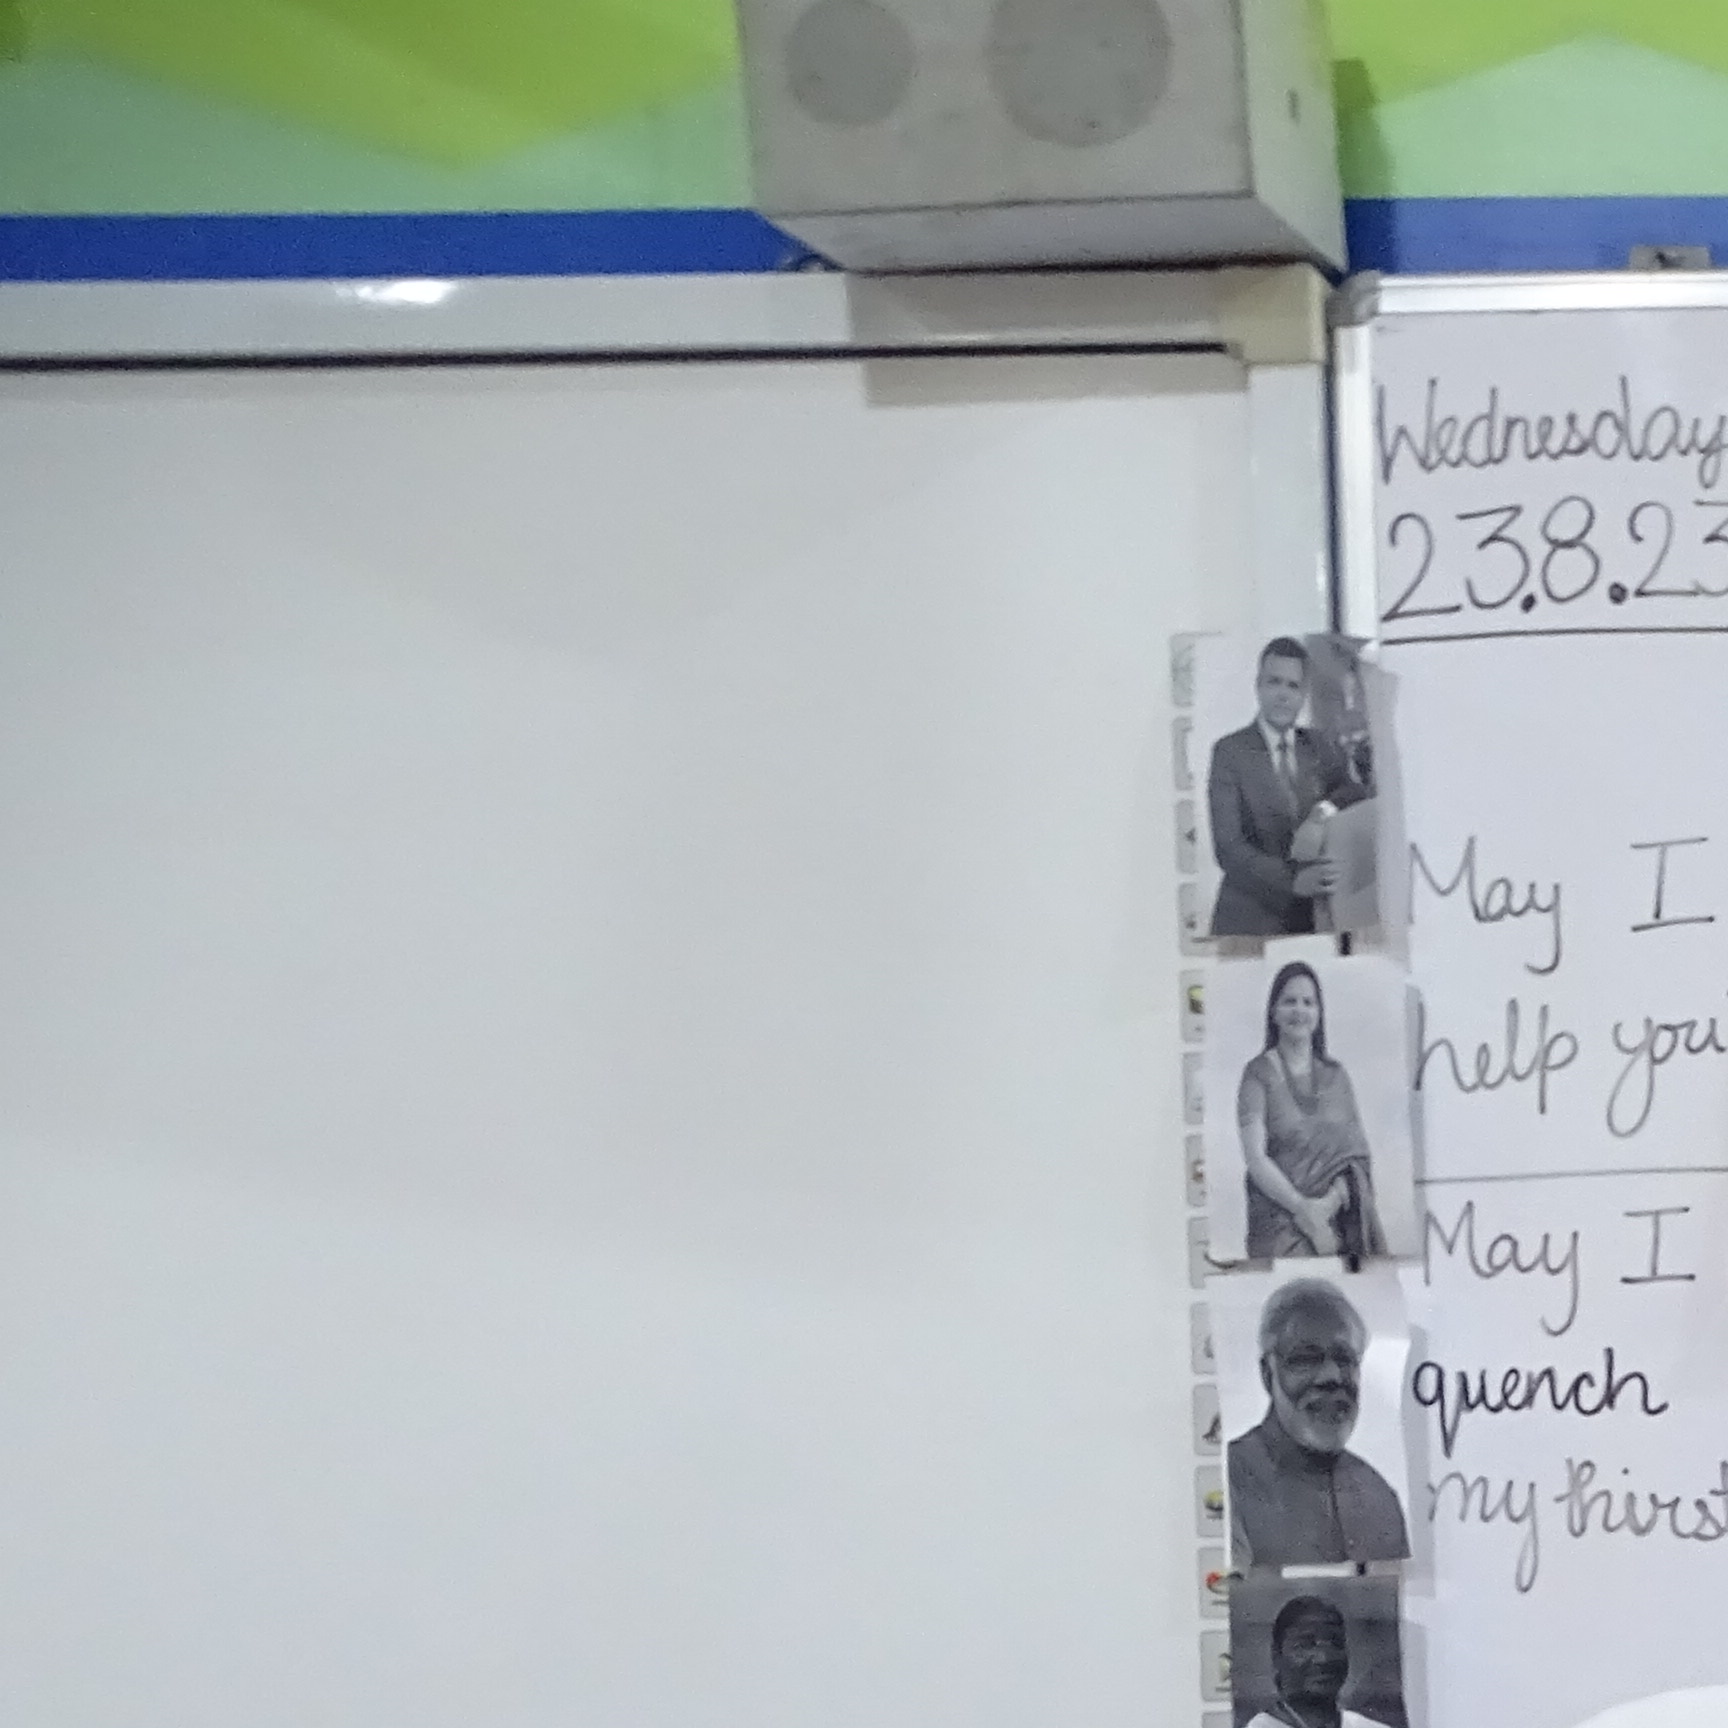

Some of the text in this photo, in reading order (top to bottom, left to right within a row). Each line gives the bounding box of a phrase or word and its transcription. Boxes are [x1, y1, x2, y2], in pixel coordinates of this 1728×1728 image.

[1405, 835, 1716, 976] May I
[1414, 997, 1580, 1116] help
[1421, 1199, 1697, 1337] May I
[1412, 1346, 1670, 1460] quench
